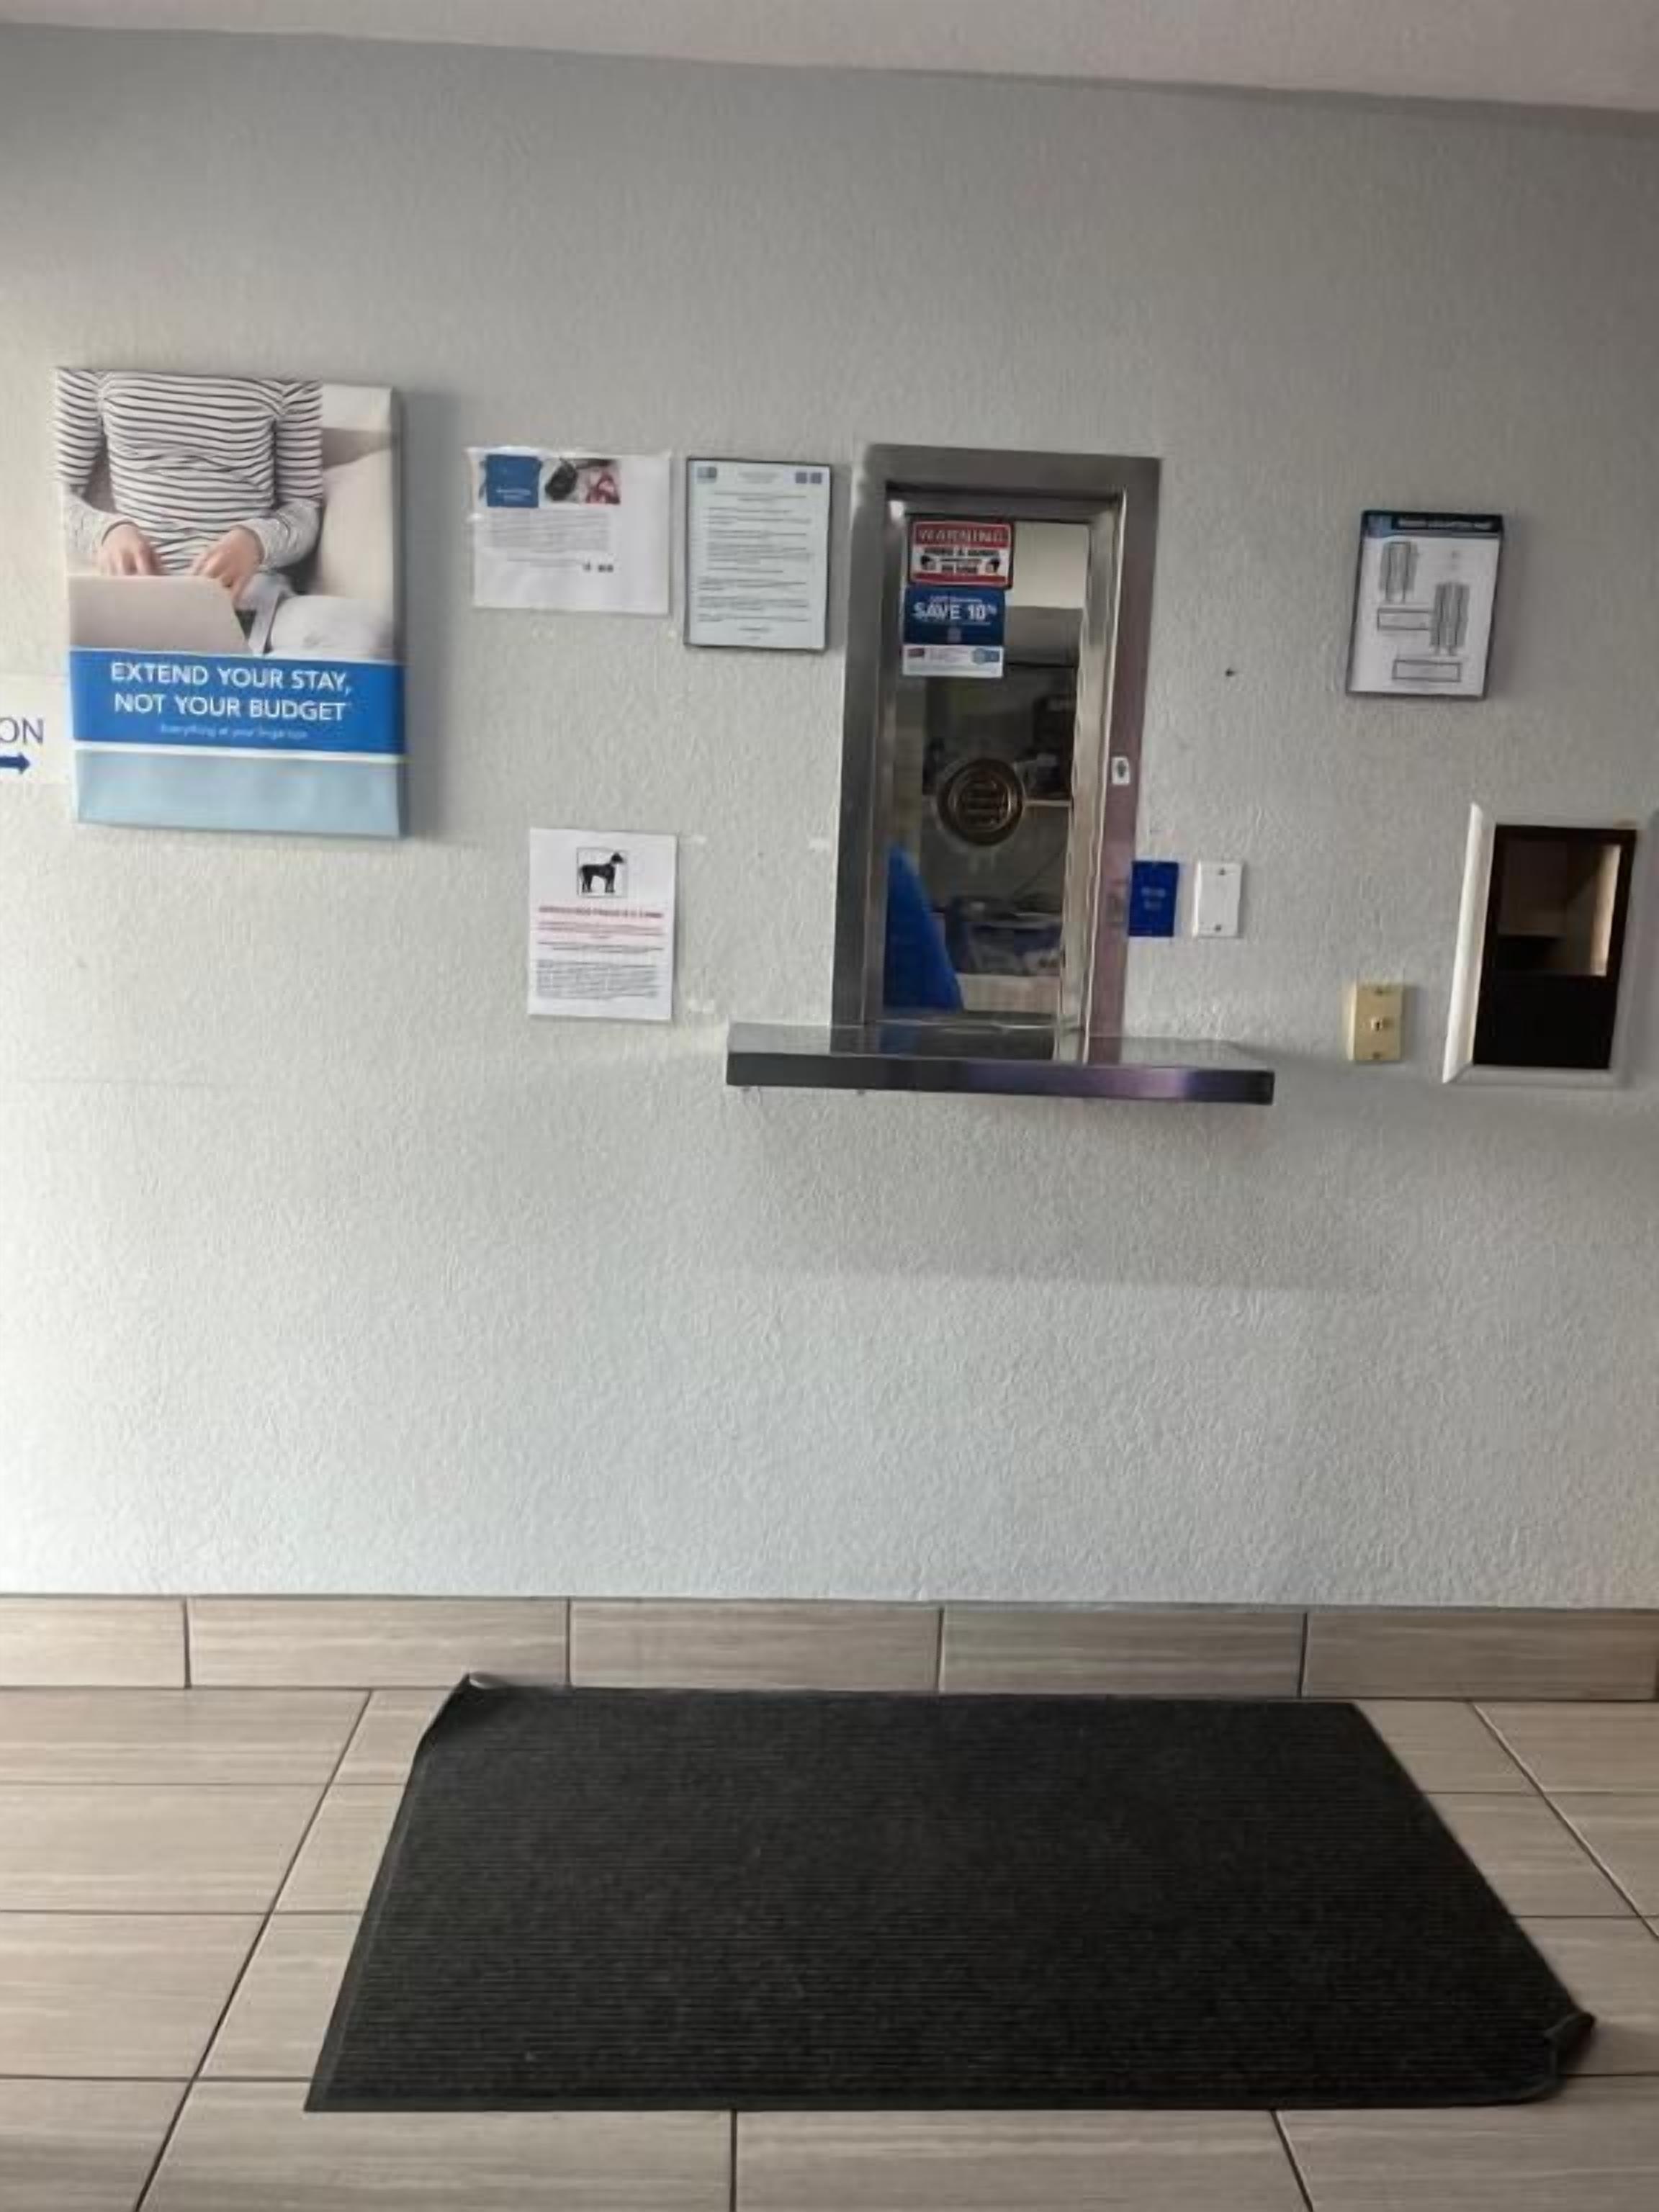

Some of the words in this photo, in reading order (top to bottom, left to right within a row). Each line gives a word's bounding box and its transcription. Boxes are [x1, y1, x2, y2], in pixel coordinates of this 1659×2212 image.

[920, 529, 1006, 542] WARNING
[913, 602, 961, 621] SAVE
[111, 662, 209, 685] EXTEND
[217, 667, 283, 689] YOUR
[291, 670, 352, 695] STAY,
[114, 693, 165, 714] NOT
[174, 696, 241, 717] YOUR
[249, 701, 346, 721] BUDGET
